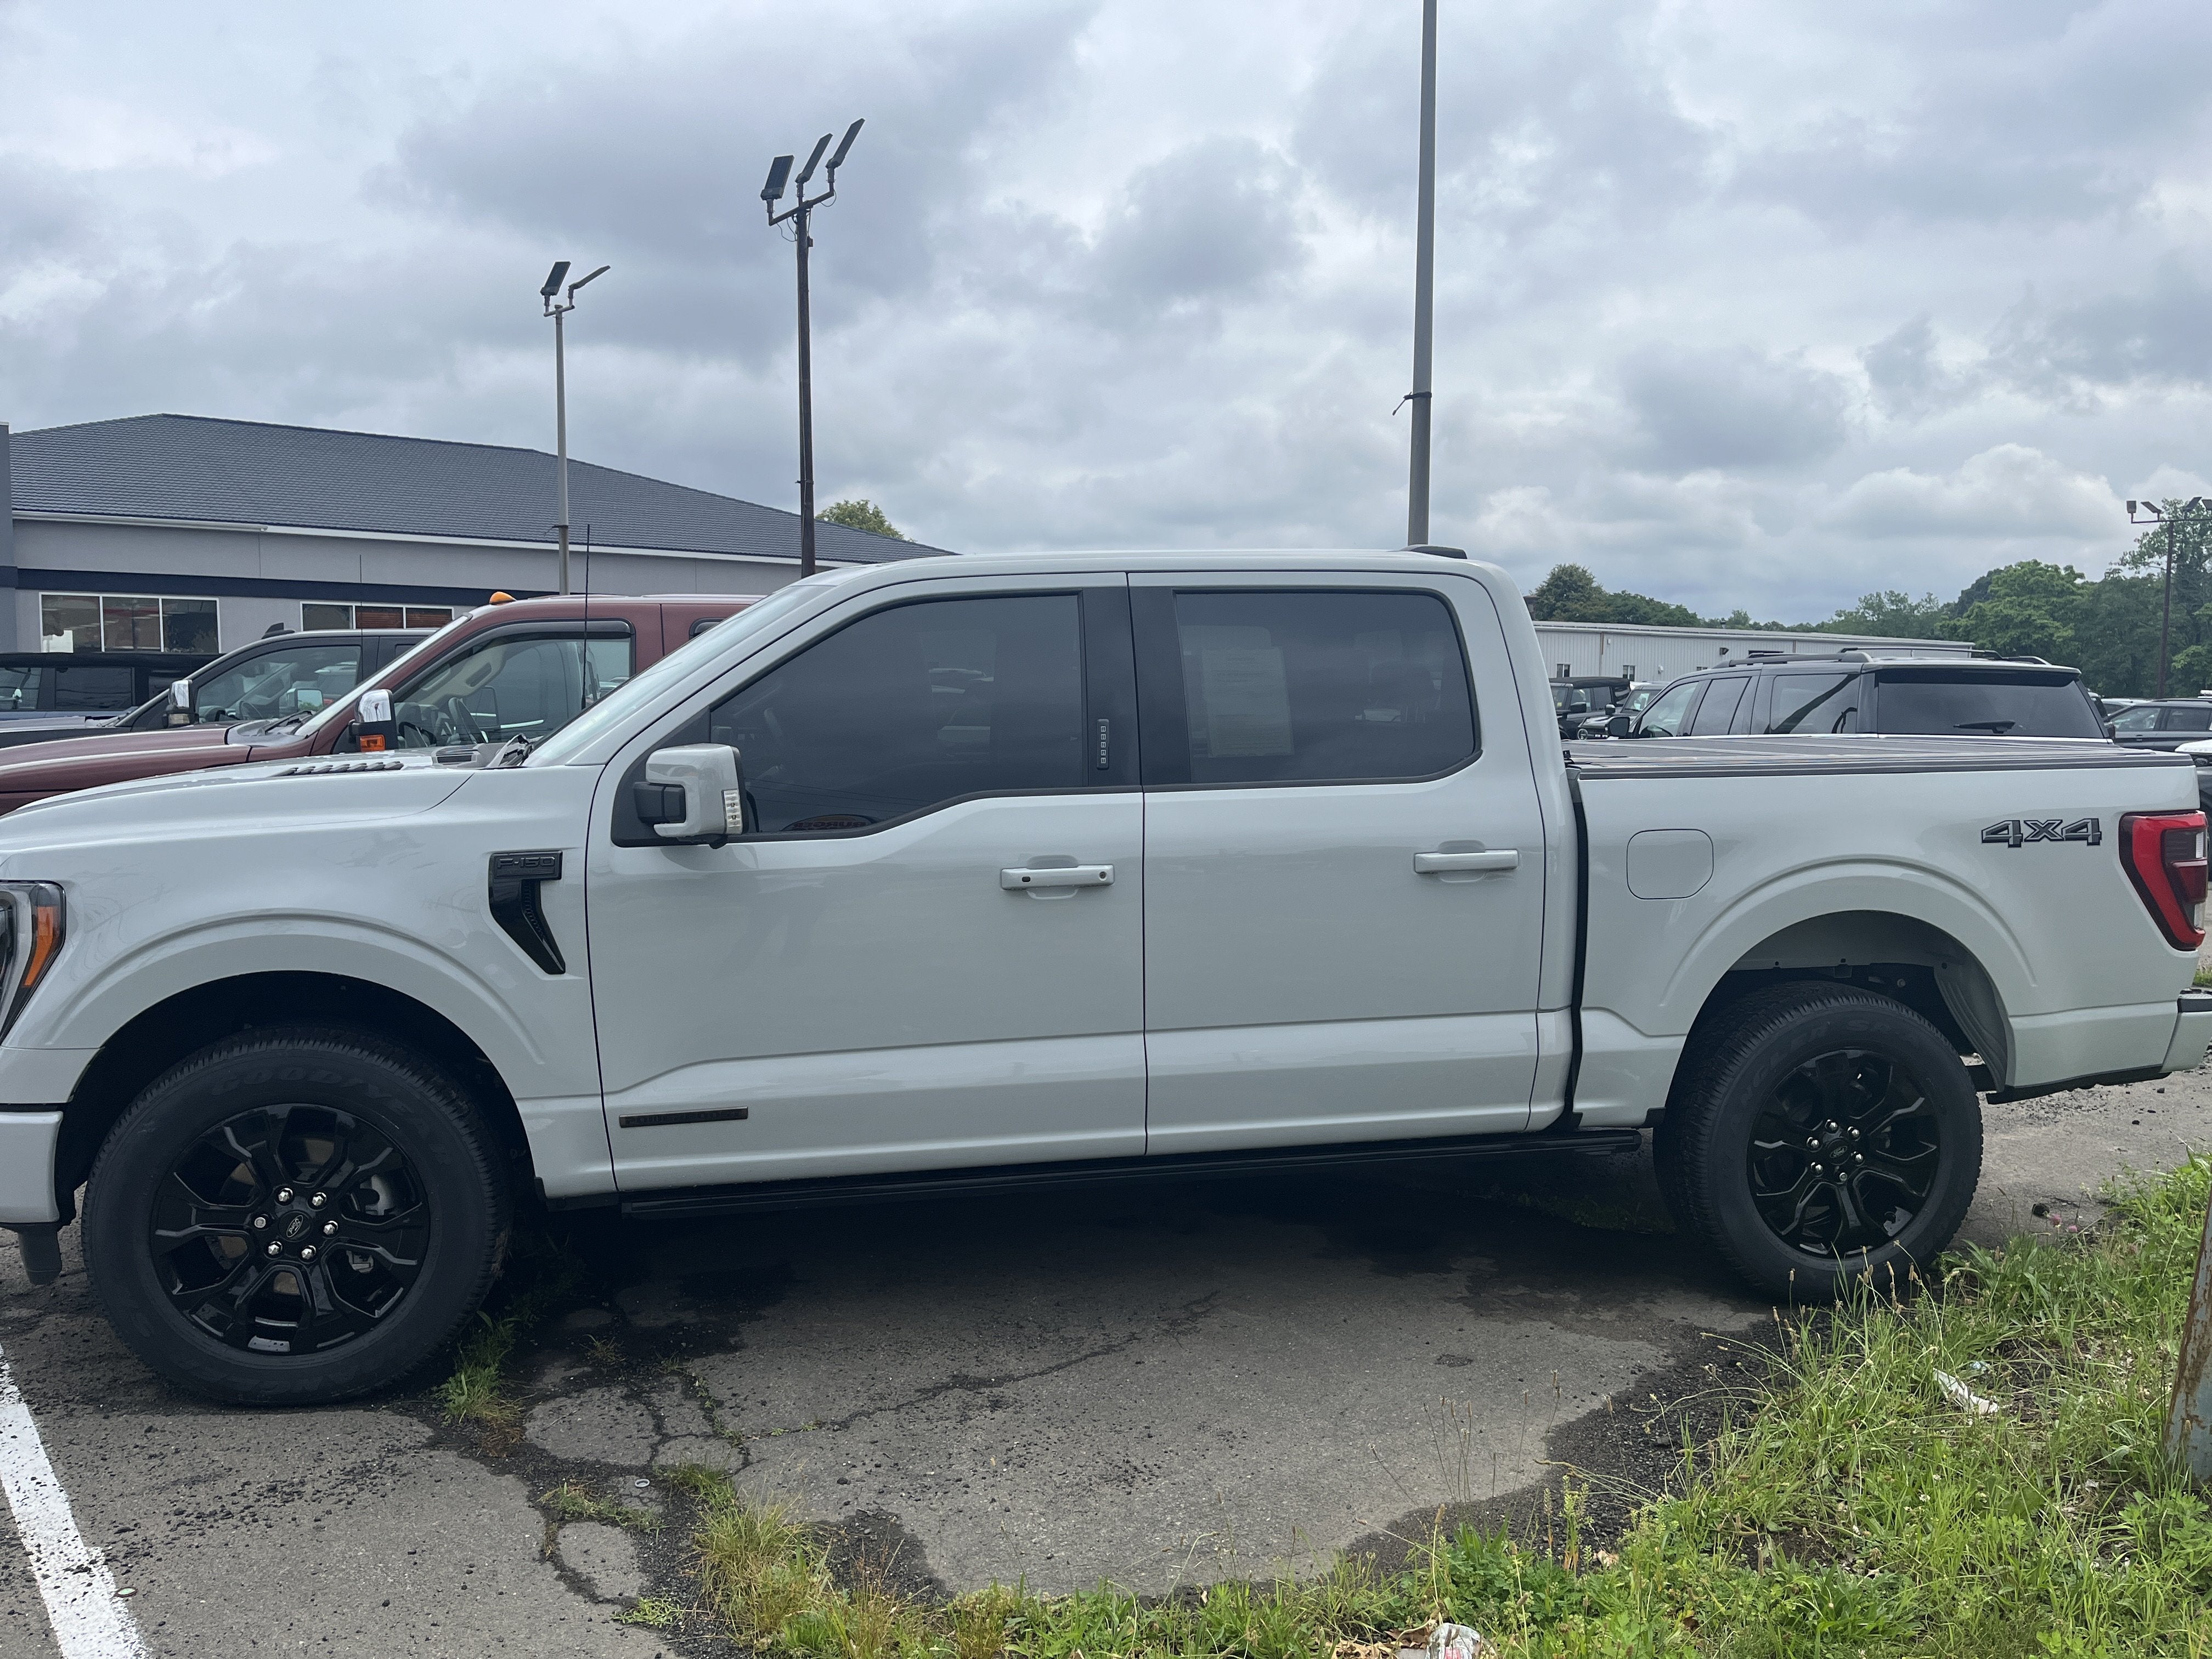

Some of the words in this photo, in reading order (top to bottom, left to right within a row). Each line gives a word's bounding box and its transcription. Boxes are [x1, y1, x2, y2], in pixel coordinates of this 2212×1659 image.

[497, 856, 555, 869] F-150
[211, 1066, 453, 1165] GOODYEAR
[1831, 1146, 1846, 1158] Ford
[287, 1216, 302, 1236] Ford
